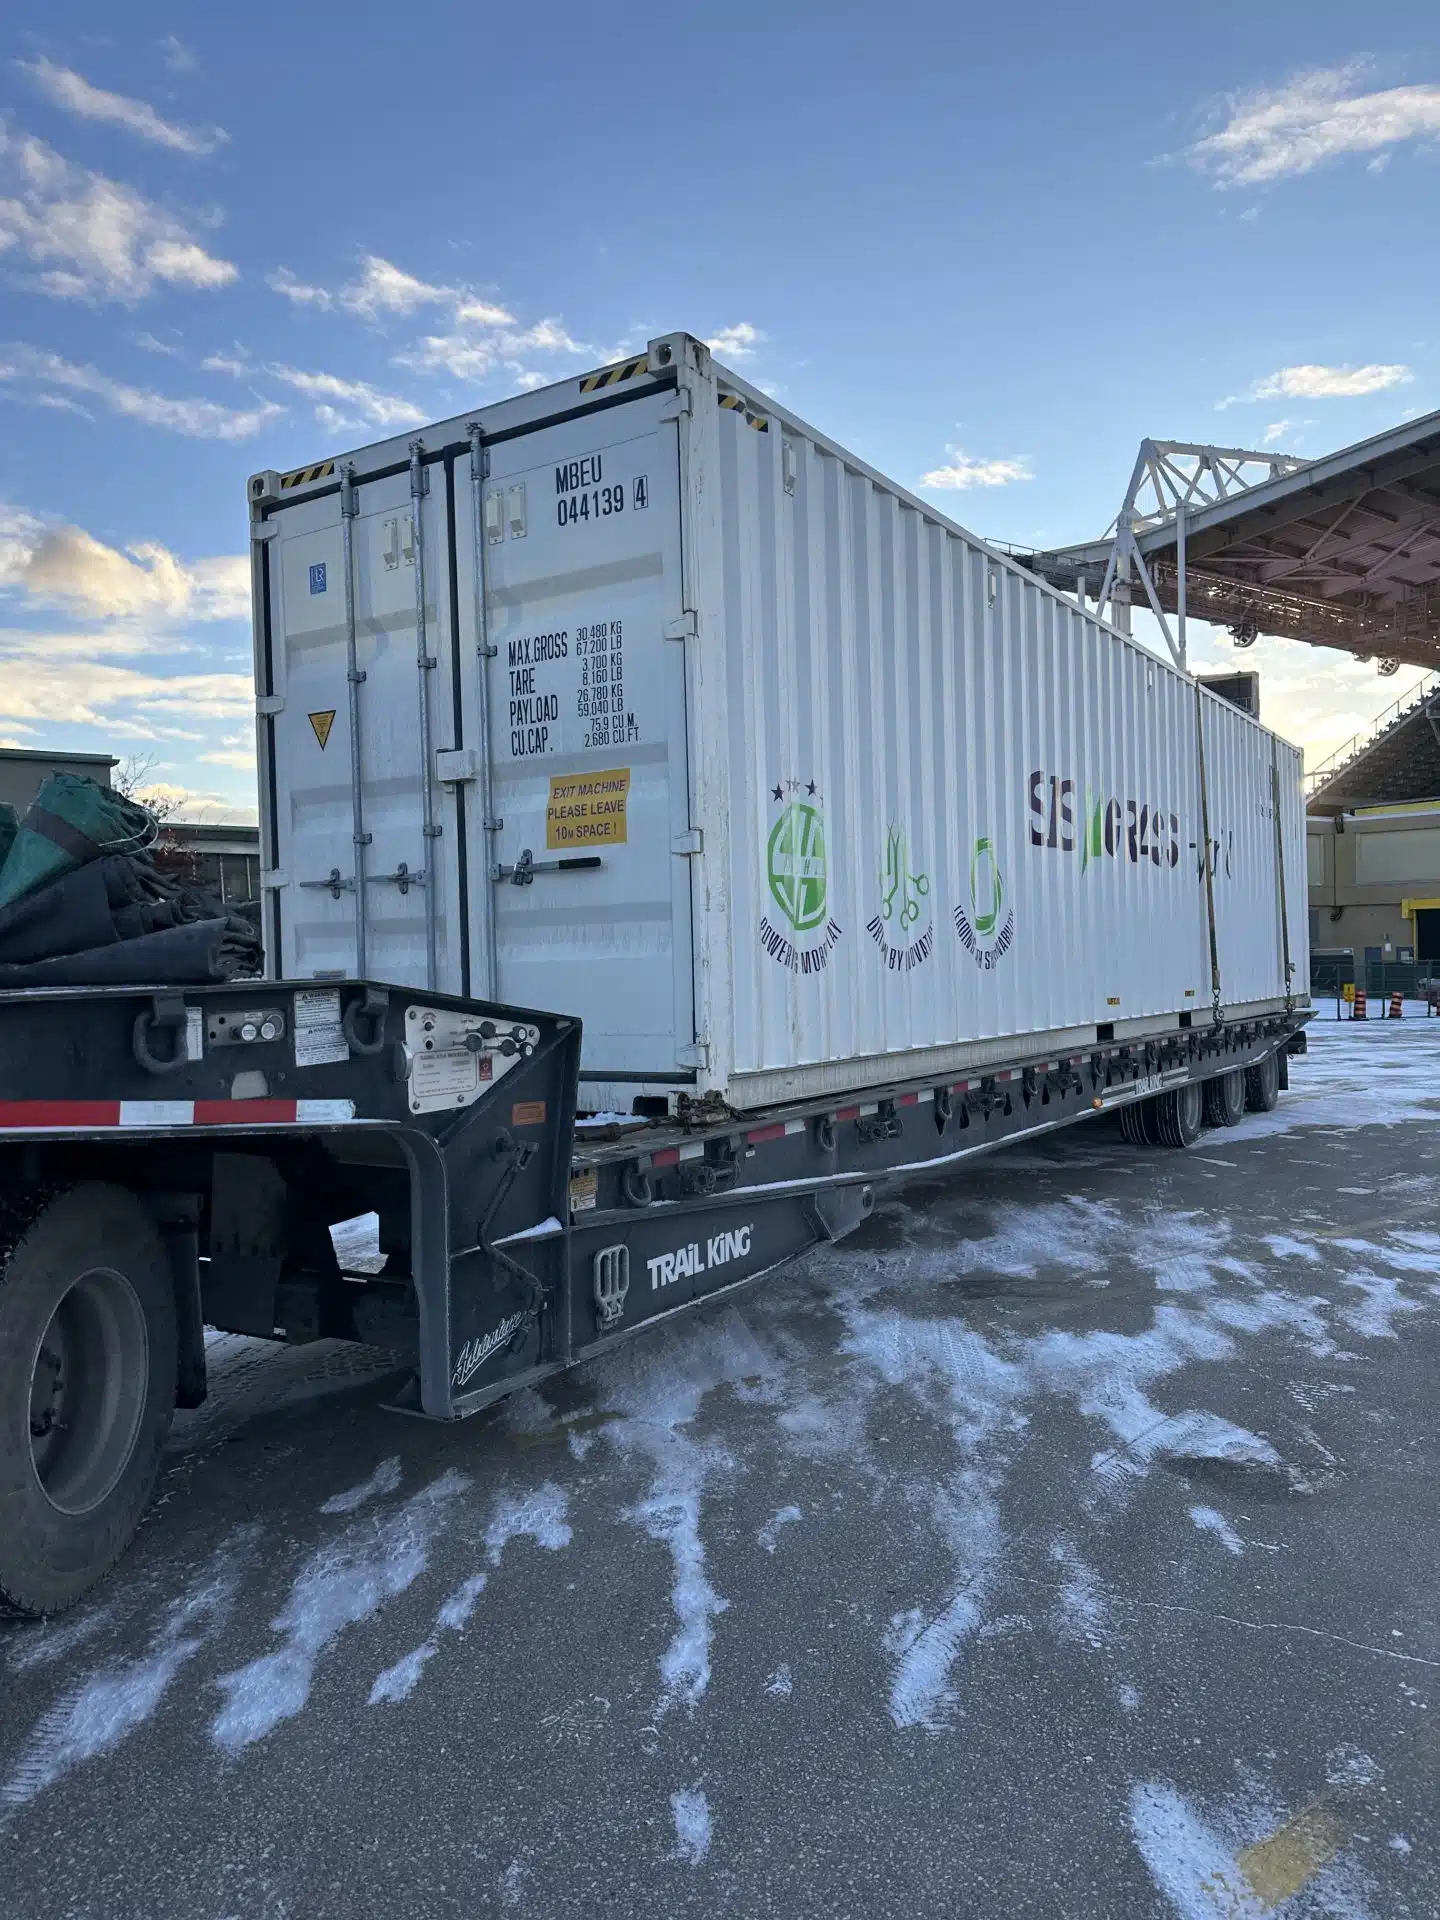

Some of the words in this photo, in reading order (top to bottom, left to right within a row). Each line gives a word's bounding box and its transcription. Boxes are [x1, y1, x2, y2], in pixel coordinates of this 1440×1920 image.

[556, 455, 602, 494] MBEU
[557, 485, 624, 527] 044139
[635, 478, 647, 508] 4
[508, 632, 568, 668] MAX.GROSS
[610, 621, 622, 635] KG
[611, 635, 622, 650] LB
[509, 668, 536, 698] TARE
[610, 652, 623, 667] KG
[611, 667, 623, 681] LB
[510, 695, 558, 727] PAYLOAD
[611, 683, 623, 698] KG
[612, 698, 624, 713] LB
[590, 717, 609, 732] 75.9
[552, 785, 576, 800] EXIT
[578, 780, 627, 797] MACHINE
[548, 804, 588, 820] PLEASE
[590, 800, 624, 816] LEAVE
[888, 948, 904, 972] BY
